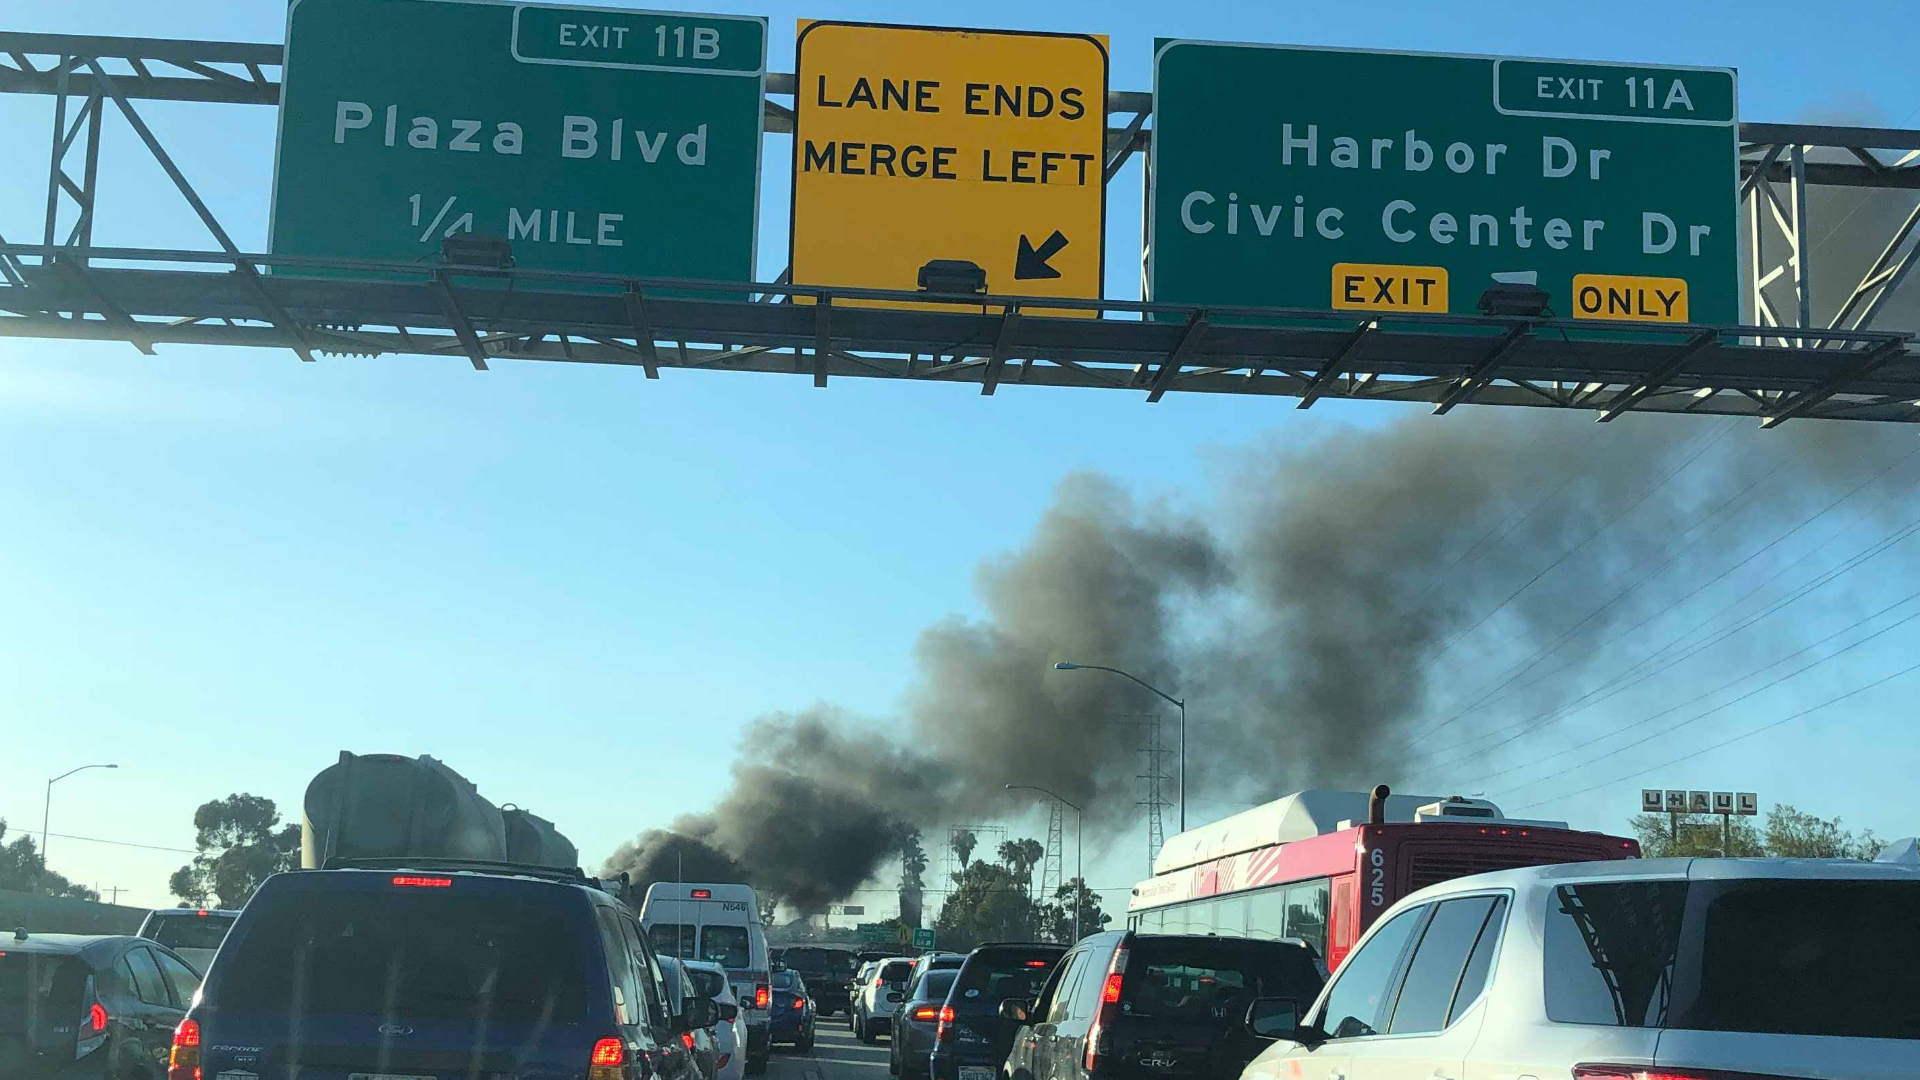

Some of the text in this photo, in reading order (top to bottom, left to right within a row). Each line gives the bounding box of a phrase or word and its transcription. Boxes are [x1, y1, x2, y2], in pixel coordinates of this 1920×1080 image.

[559, 24, 720, 60] EXIT 11B
[818, 75, 1085, 120] LANE ENDS
[1537, 75, 1694, 111] EXIT 11A
[334, 101, 708, 166] Plaza Blvd
[1282, 123, 1611, 180] Harbor Dr
[804, 140, 1095, 186] MERGE LEFT
[508, 208, 624, 247] MILE
[1181, 190, 1711, 256] Civic Center Dr
[1343, 275, 1681, 317] EXIT ONLY
[1645, 793, 1753, 808] UHAUL
[1371, 848, 1384, 906] 625
[1140, 1059, 1177, 1067] CR-V
